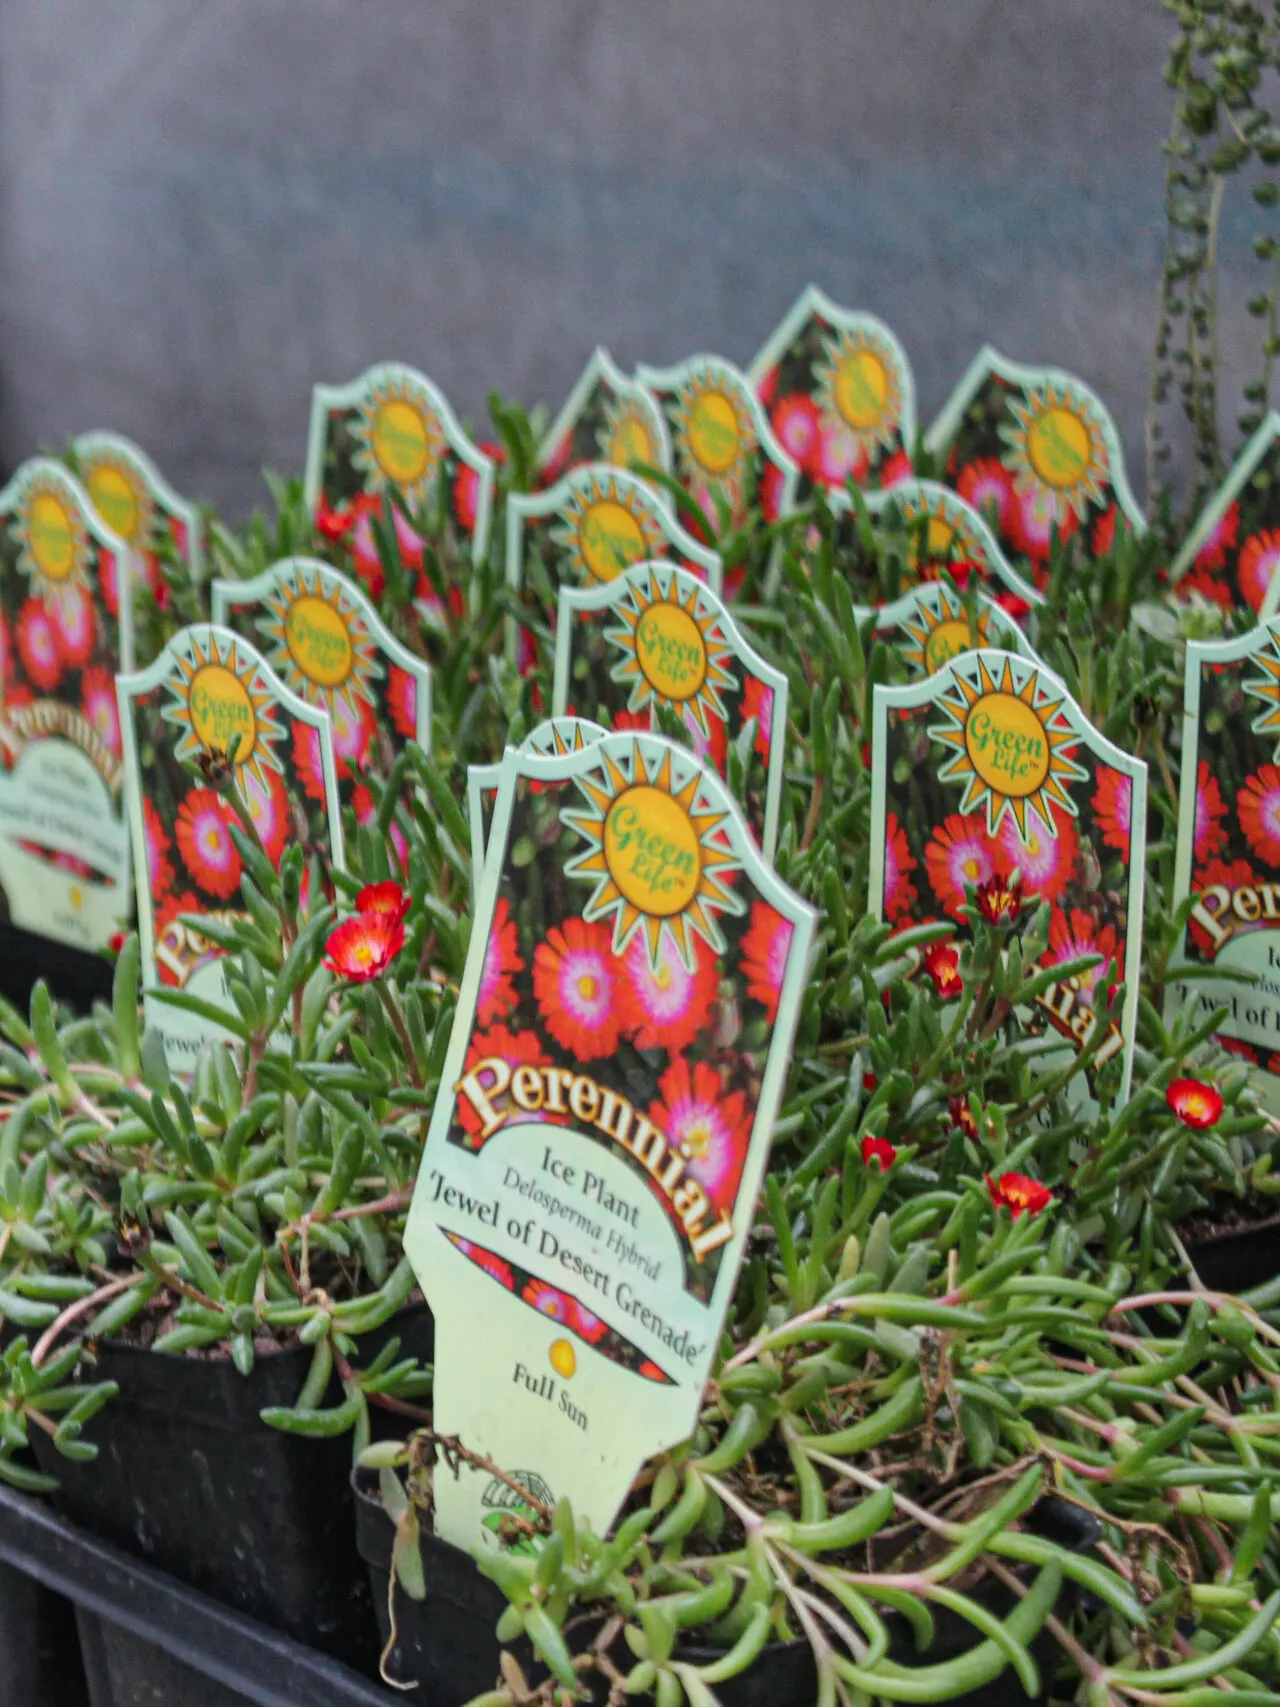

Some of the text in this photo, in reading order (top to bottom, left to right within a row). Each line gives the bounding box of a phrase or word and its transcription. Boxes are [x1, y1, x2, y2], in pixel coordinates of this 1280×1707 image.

[640, 619, 702, 666] Green
[969, 712, 1042, 759] Green
[610, 804, 696, 876] Green
[453, 1055, 735, 1265] Perennial
[540, 1146, 642, 1229] Ice Plant
[502, 1167, 662, 1283] Delosperma Hybrid
[507, 1219, 535, 1247] of
[539, 1229, 612, 1297] Desert
[512, 1361, 590, 1432] Full Sun
